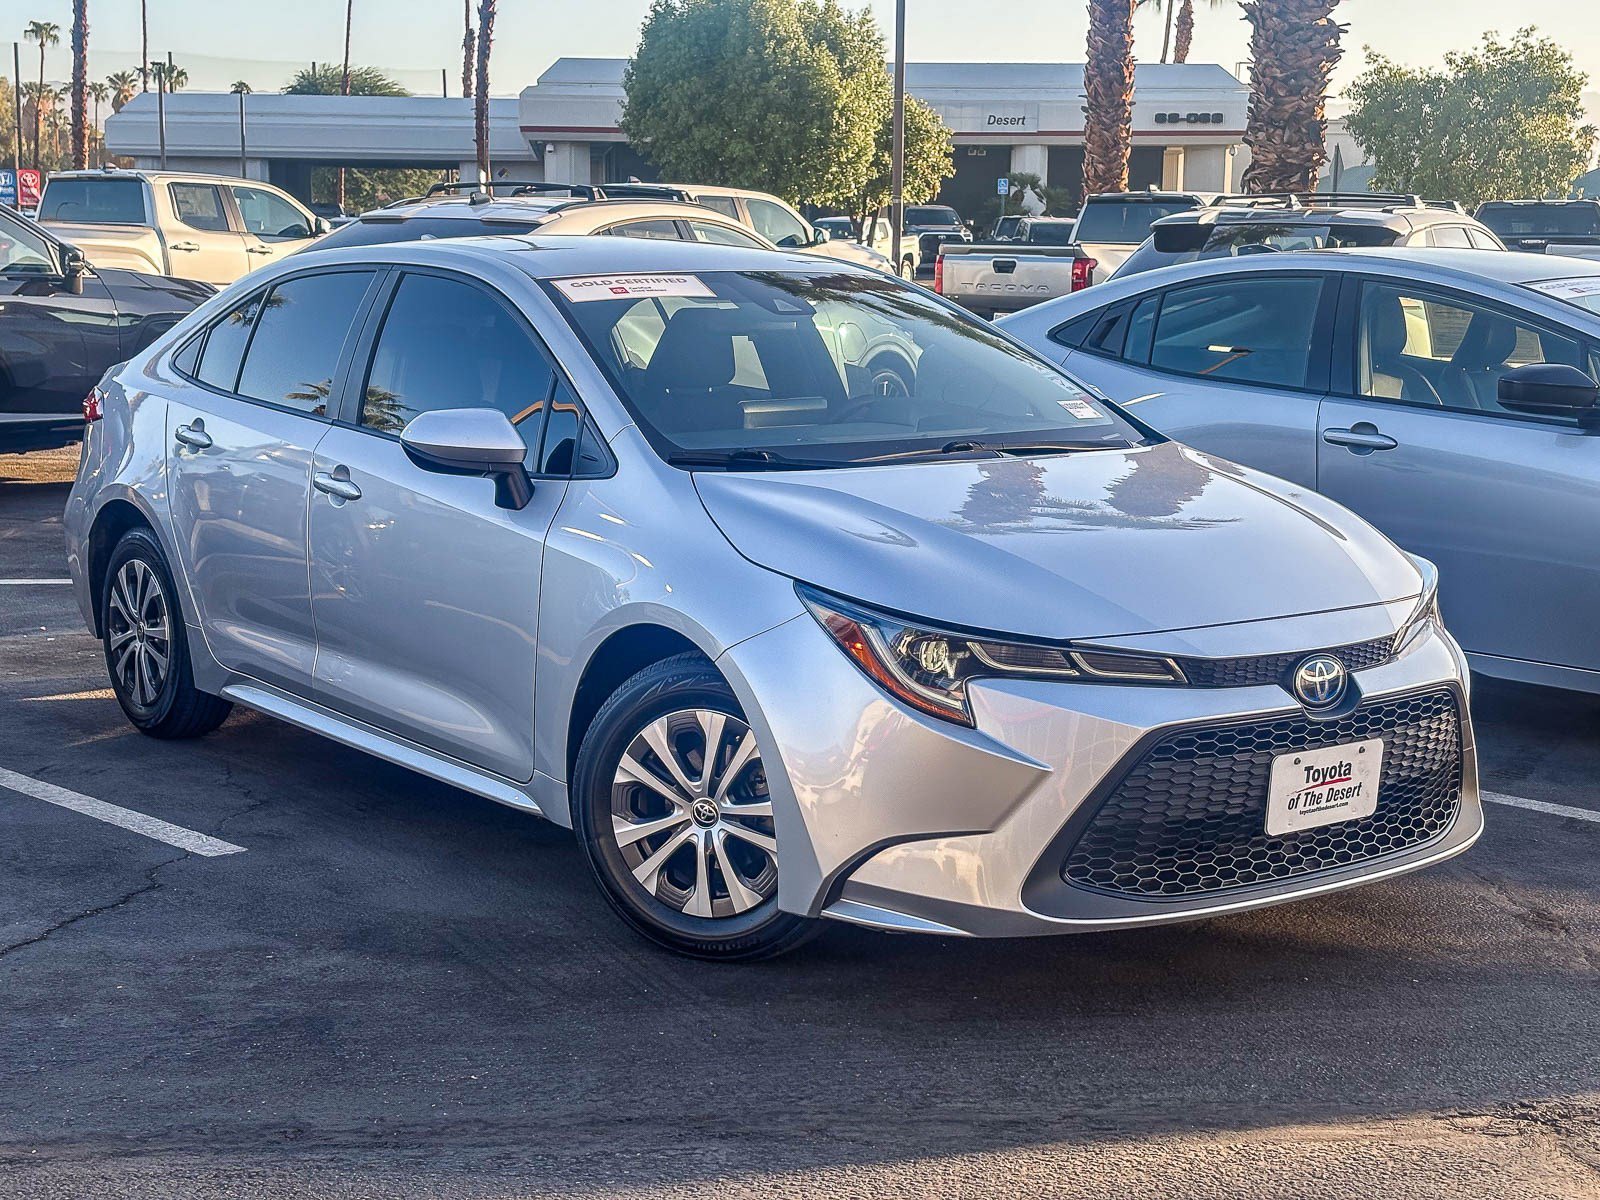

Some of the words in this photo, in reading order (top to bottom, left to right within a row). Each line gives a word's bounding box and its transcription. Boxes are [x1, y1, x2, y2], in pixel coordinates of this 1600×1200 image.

[987, 114, 1026, 126] Desert
[570, 279, 613, 288] GOLD
[614, 277, 688, 286] CERTIFIED
[960, 282, 1050, 293] TACOMA
[1304, 760, 1353, 784] Toyota
[1287, 793, 1301, 811] of
[1302, 790, 1323, 808] The
[1324, 781, 1363, 801] Desert
